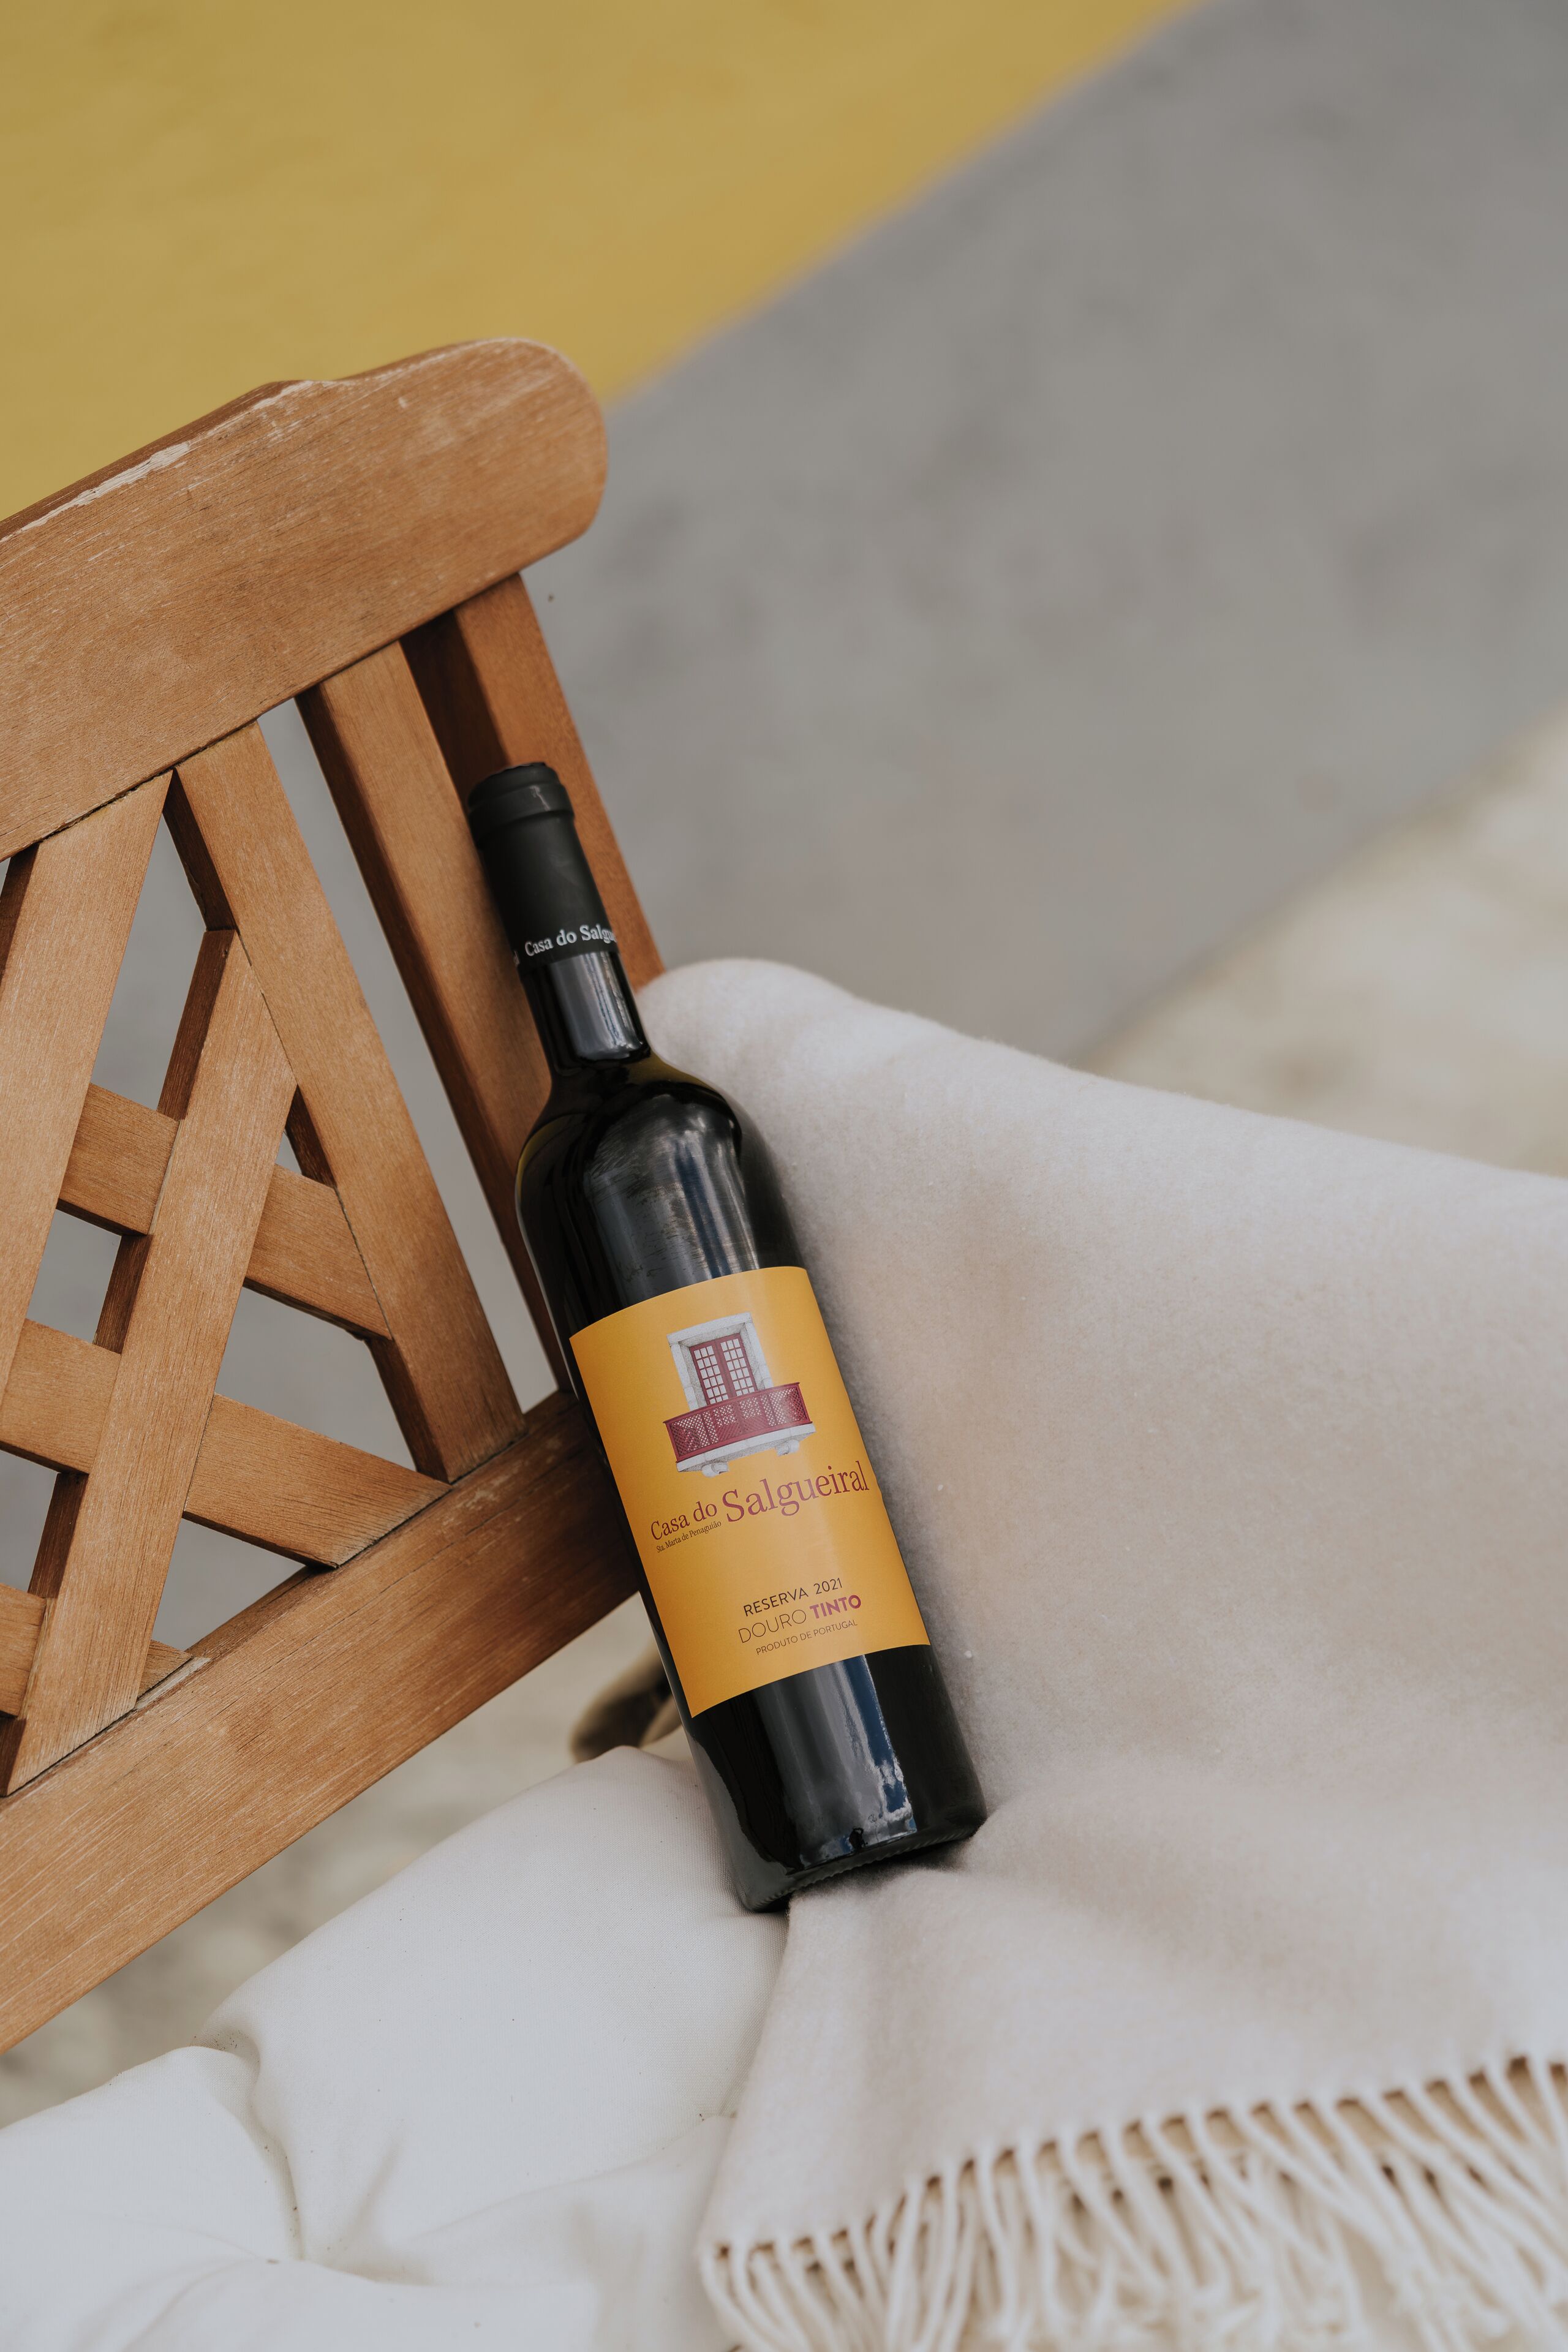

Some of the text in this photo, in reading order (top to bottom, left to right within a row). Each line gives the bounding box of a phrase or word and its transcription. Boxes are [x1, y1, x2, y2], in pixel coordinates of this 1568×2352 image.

[525, 938, 554, 956] Casa
[556, 929, 578, 946] do
[650, 1460, 870, 1540] Casa do Salgueiral
[665, 1537, 682, 1548] Marta
[689, 1521, 722, 1537] Penaguião
[743, 1577, 843, 1617] RESERVA 2021
[738, 1594, 862, 1643] DOURO TINTO
[756, 1619, 858, 1656] PRODUTO DE PORTUGAL
